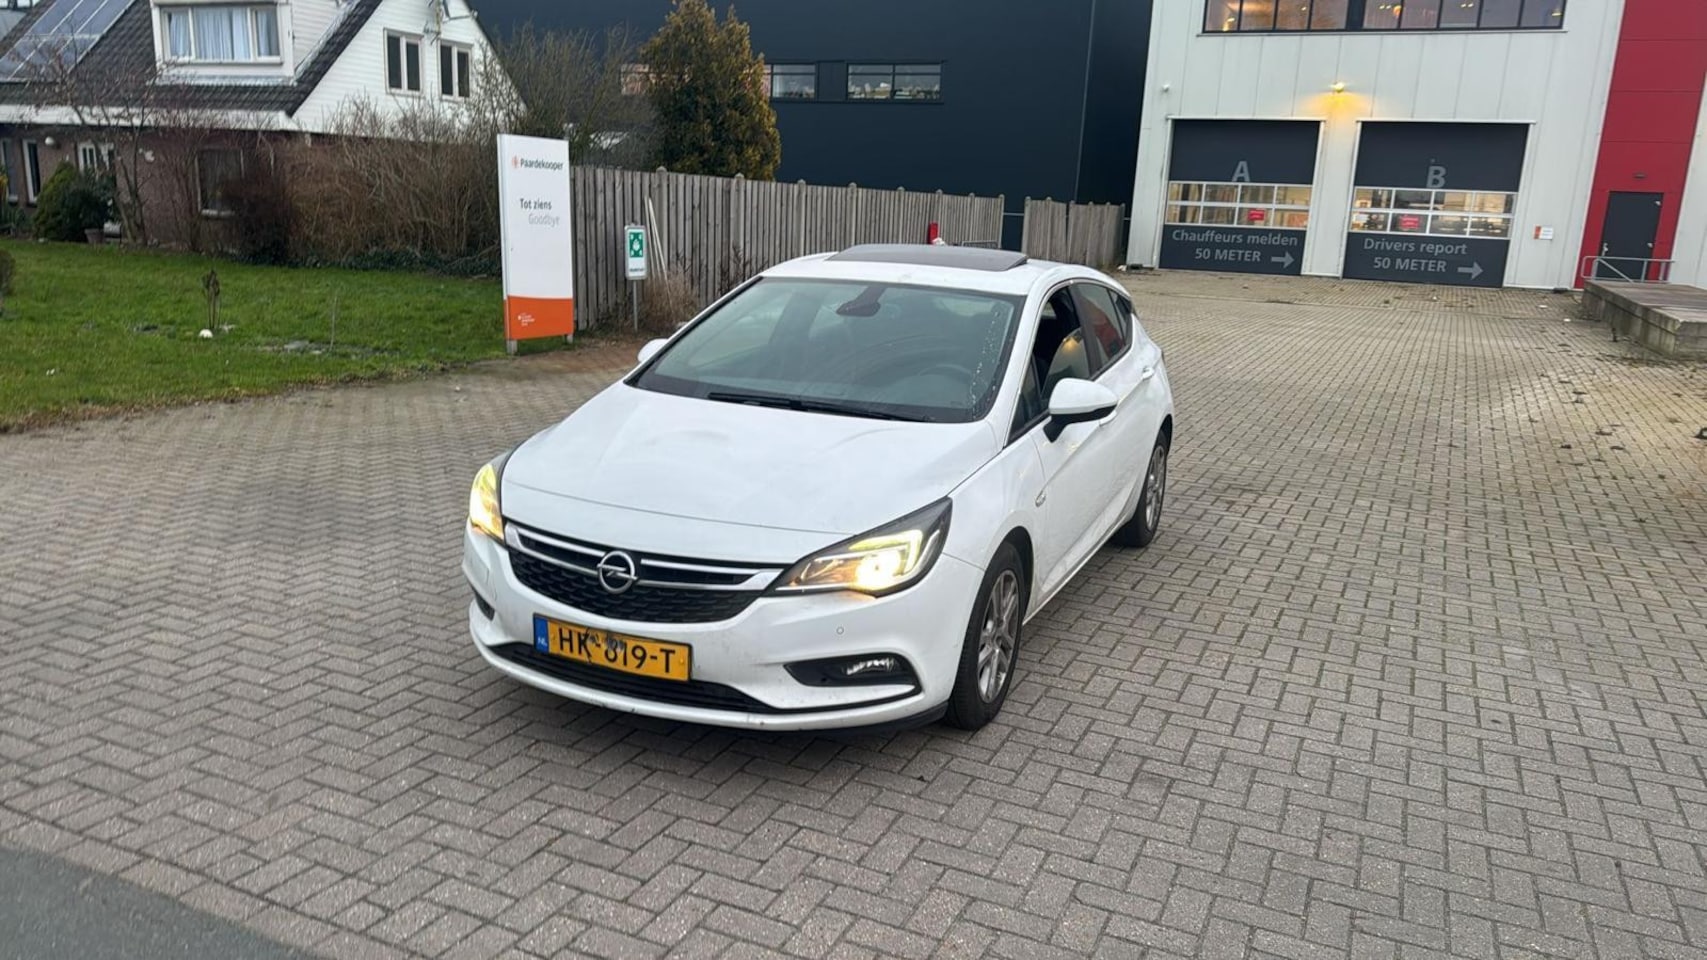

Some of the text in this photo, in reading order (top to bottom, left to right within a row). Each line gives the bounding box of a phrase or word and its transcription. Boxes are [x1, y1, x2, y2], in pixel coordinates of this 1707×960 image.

[521, 158, 563, 170] Paardekooper
[1231, 161, 1250, 182] A
[1426, 166, 1446, 188] B
[520, 198, 552, 210] Tot ziens
[529, 213, 560, 227] Goodbye
[1172, 229, 1298, 246] Chauffeurs melden
[1364, 238, 1467, 256] Drivers report
[1195, 248, 1261, 262] 50 METER
[1374, 257, 1447, 272] 50 METER
[537, 636, 547, 646] NL
